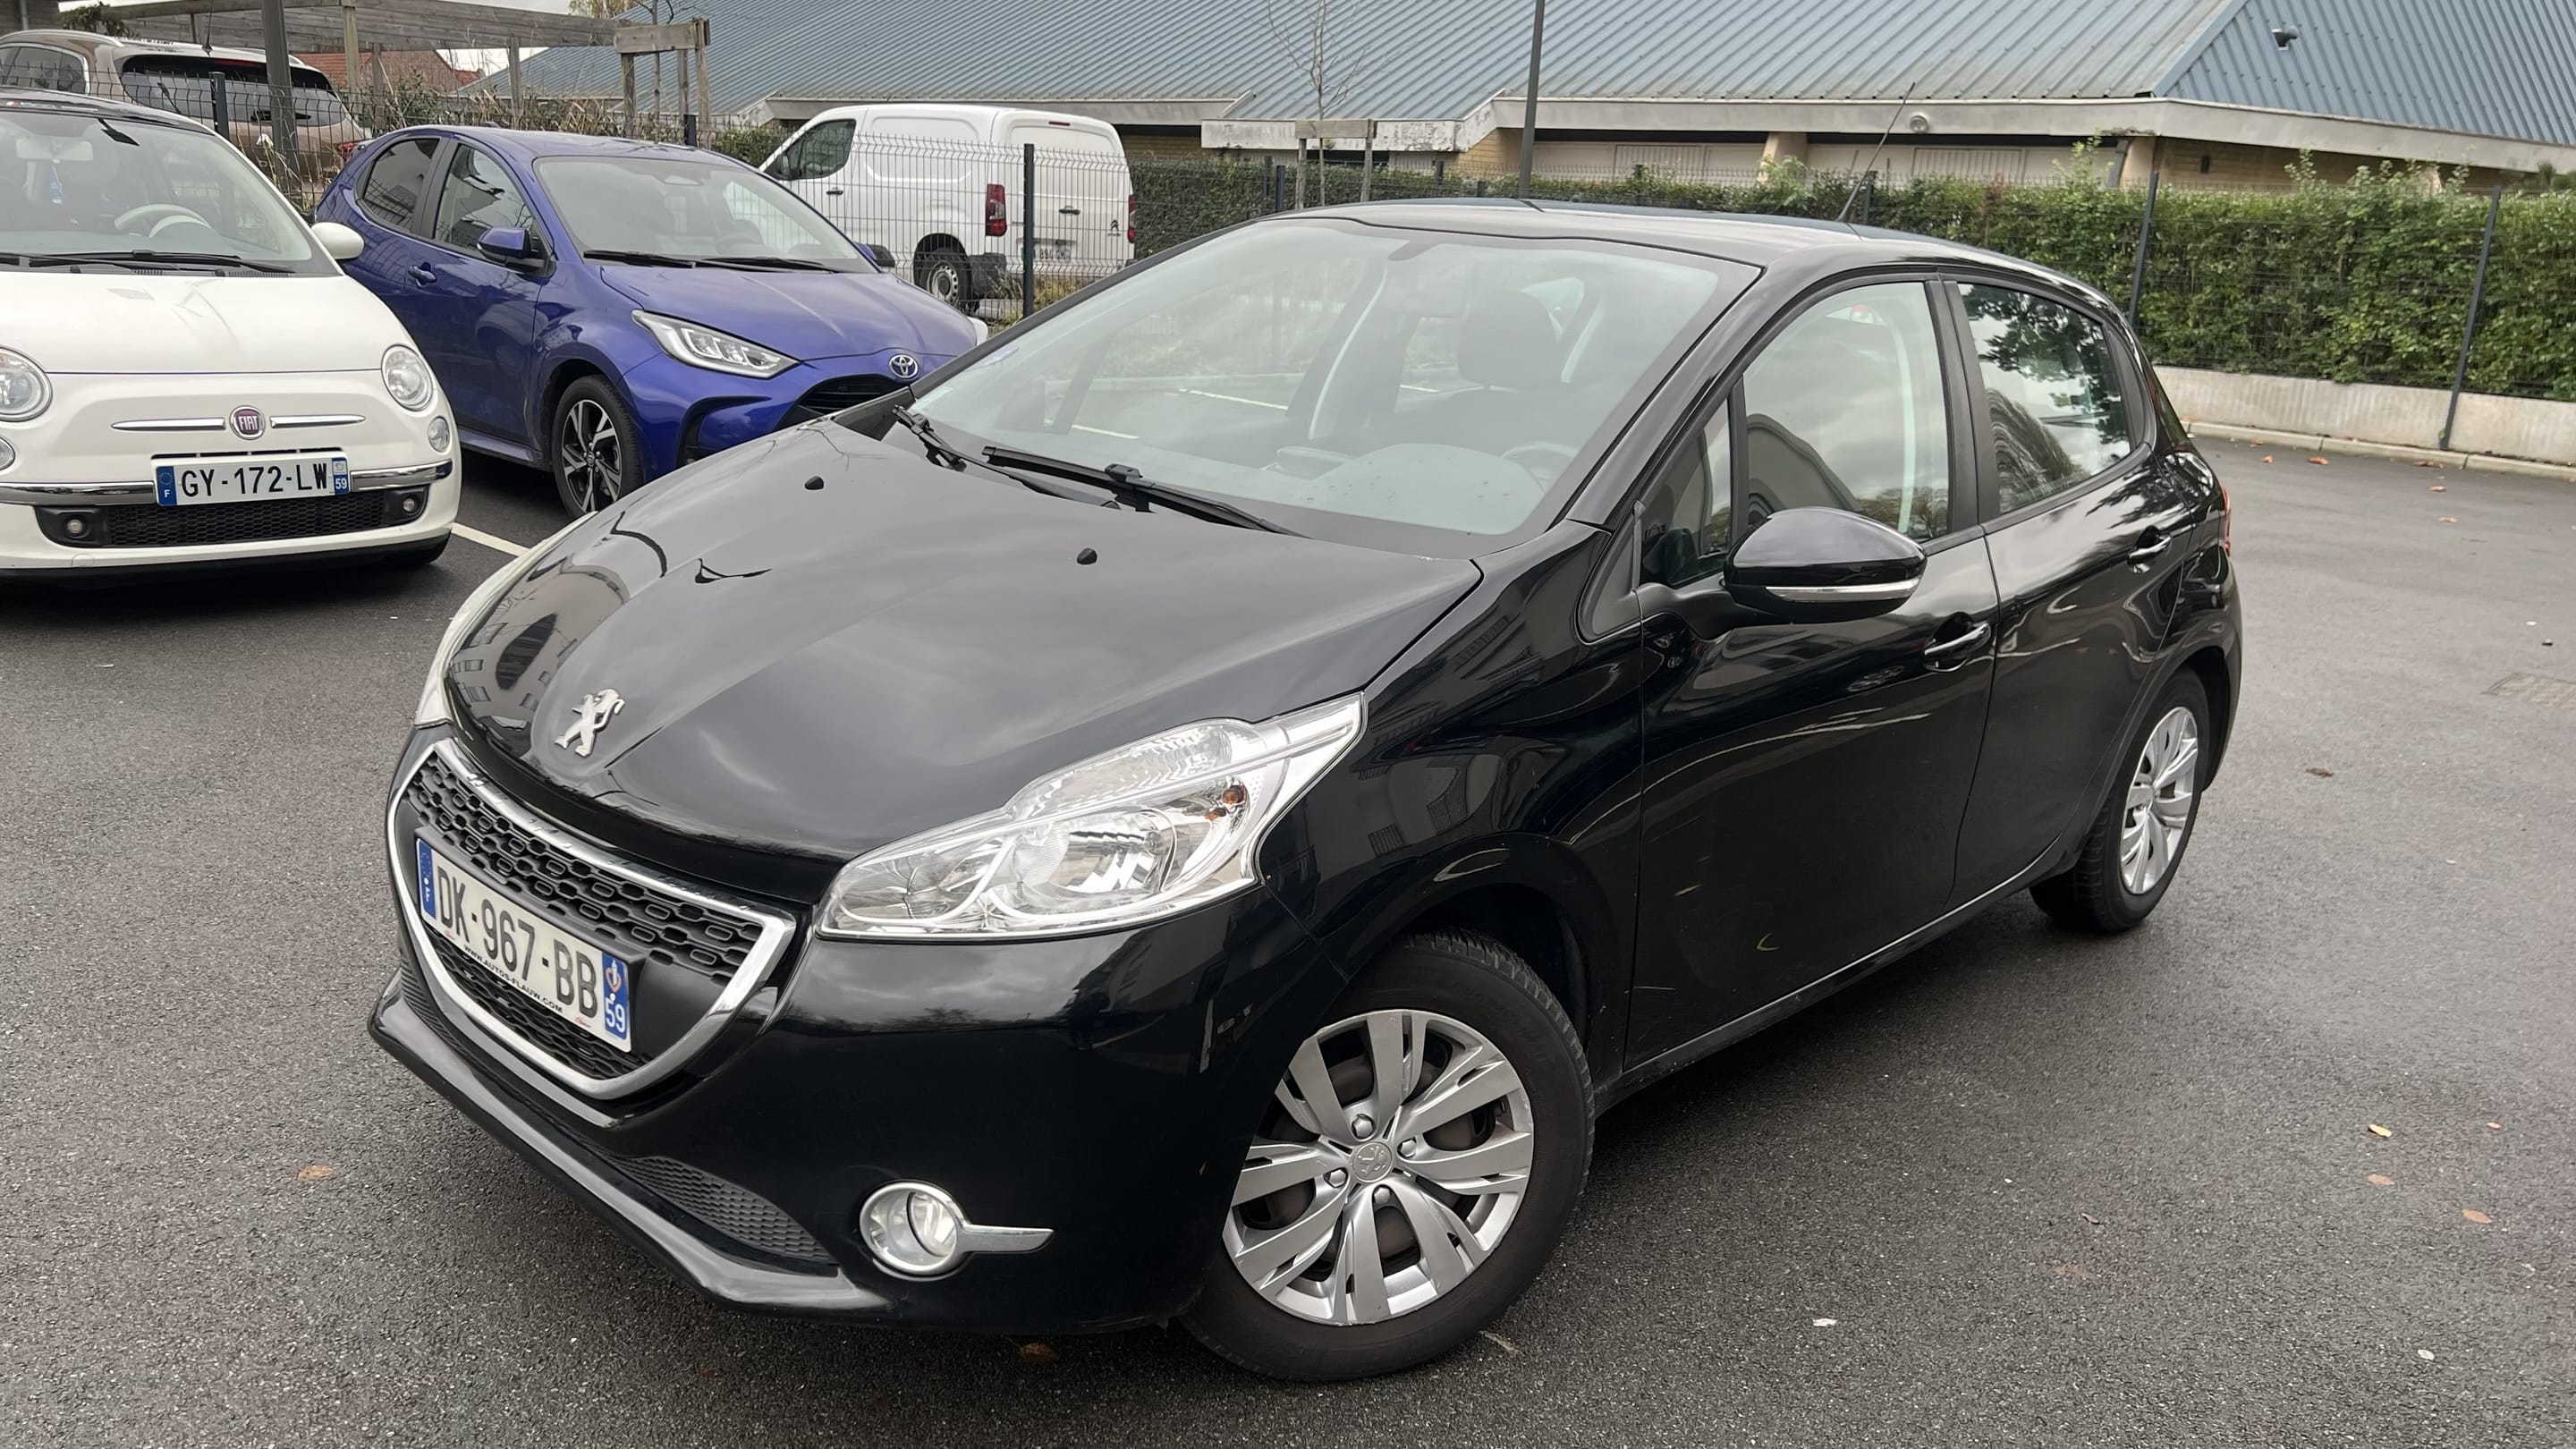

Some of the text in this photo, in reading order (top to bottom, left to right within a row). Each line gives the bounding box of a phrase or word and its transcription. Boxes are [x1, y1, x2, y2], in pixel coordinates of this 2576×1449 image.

[238, 414, 259, 431] FIAT
[182, 462, 327, 497] GY-172-LW
[335, 478, 347, 489] 59
[164, 489, 171, 498] F
[437, 865, 598, 1019] DK-967-BB
[604, 996, 625, 1033] 59
